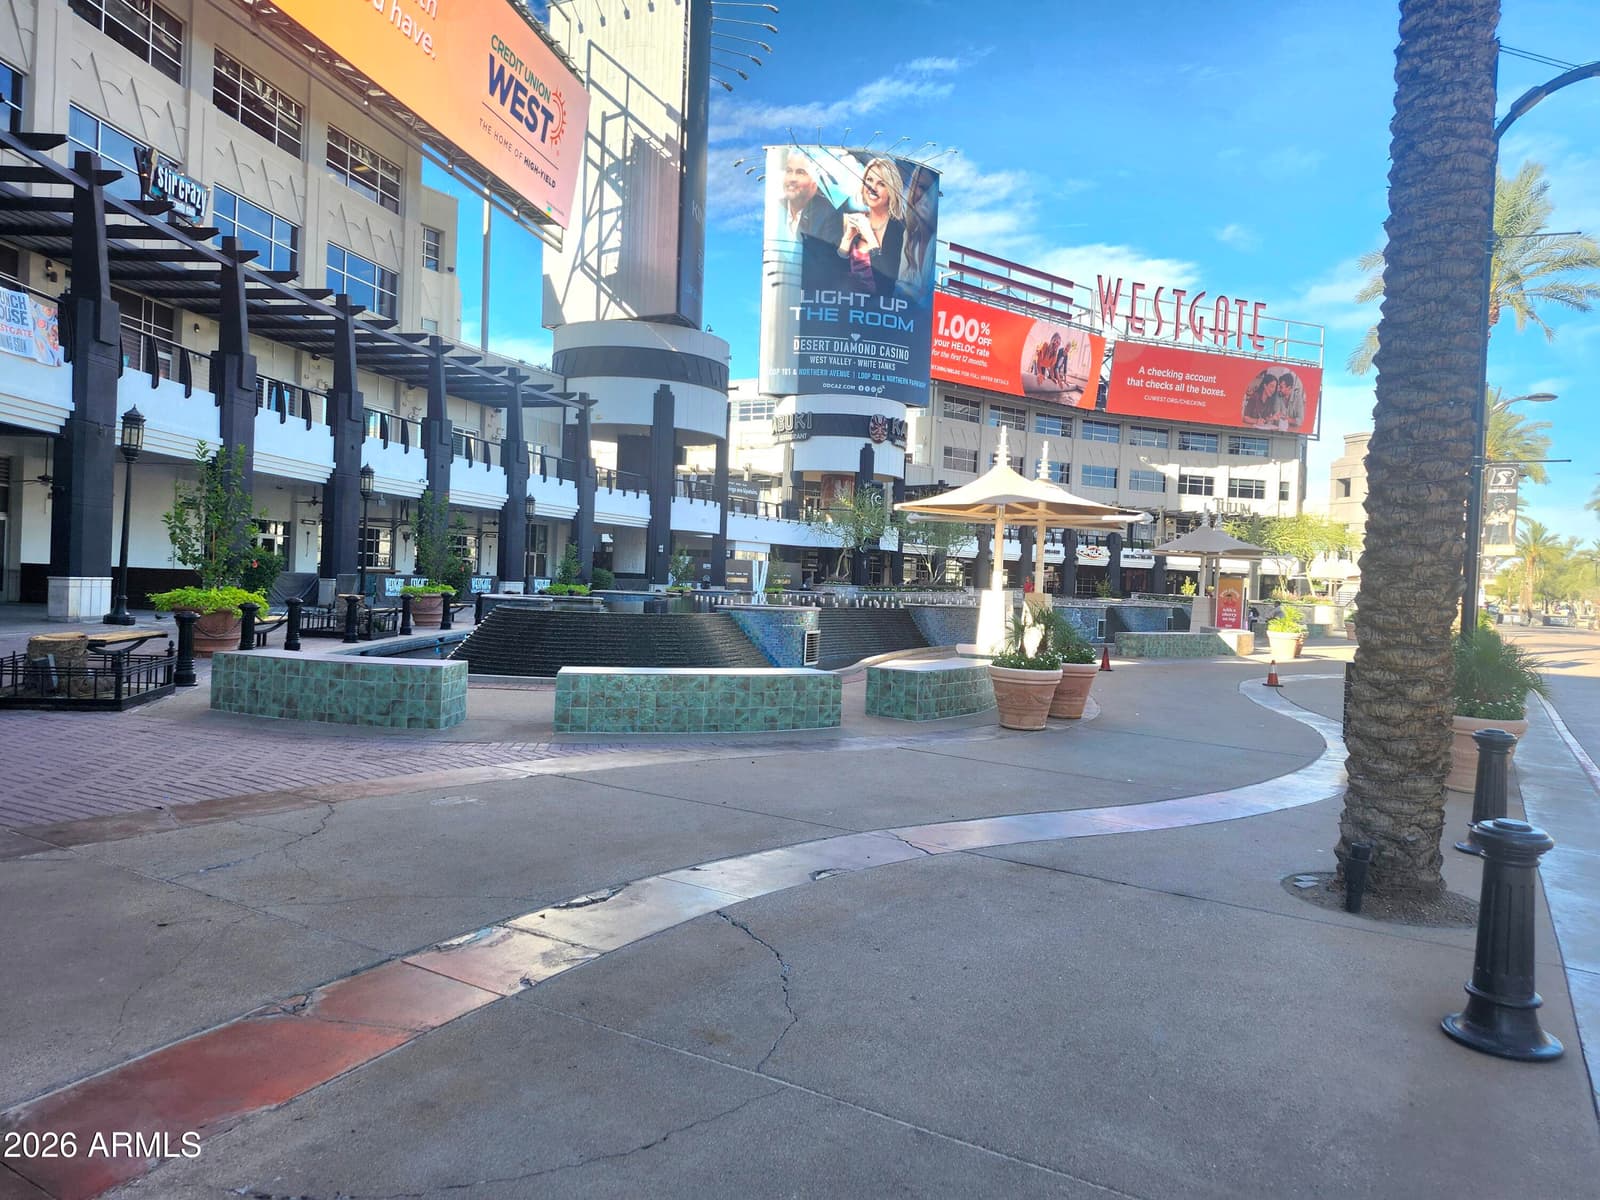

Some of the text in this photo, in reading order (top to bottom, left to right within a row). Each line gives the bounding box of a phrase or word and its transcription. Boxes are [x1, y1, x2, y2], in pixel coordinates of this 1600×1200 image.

[389, 0, 436, 59] have.
[491, 34, 551, 104] CREDIT UNION
[489, 52, 554, 144] WEST
[479, 118, 557, 189] THE HOME OF HIGH-YIELD
[800, 289, 908, 312] LIGHT UP
[790, 306, 914, 332] THE ROOM
[1096, 274, 1267, 351] WESTGATE
[793, 338, 909, 361] DESERT DIAMOND CASINO
[934, 338, 990, 358] your HELOC rate
[977, 336, 993, 347] OFF
[810, 355, 896, 371] WEST VALLEY WHITE TANKS
[829, 370, 851, 379] AVENUE
[1138, 366, 1216, 383] A checking account
[1127, 377, 1226, 397] that checks all the boxes.
[1212, 497, 1251, 515] TULUM
